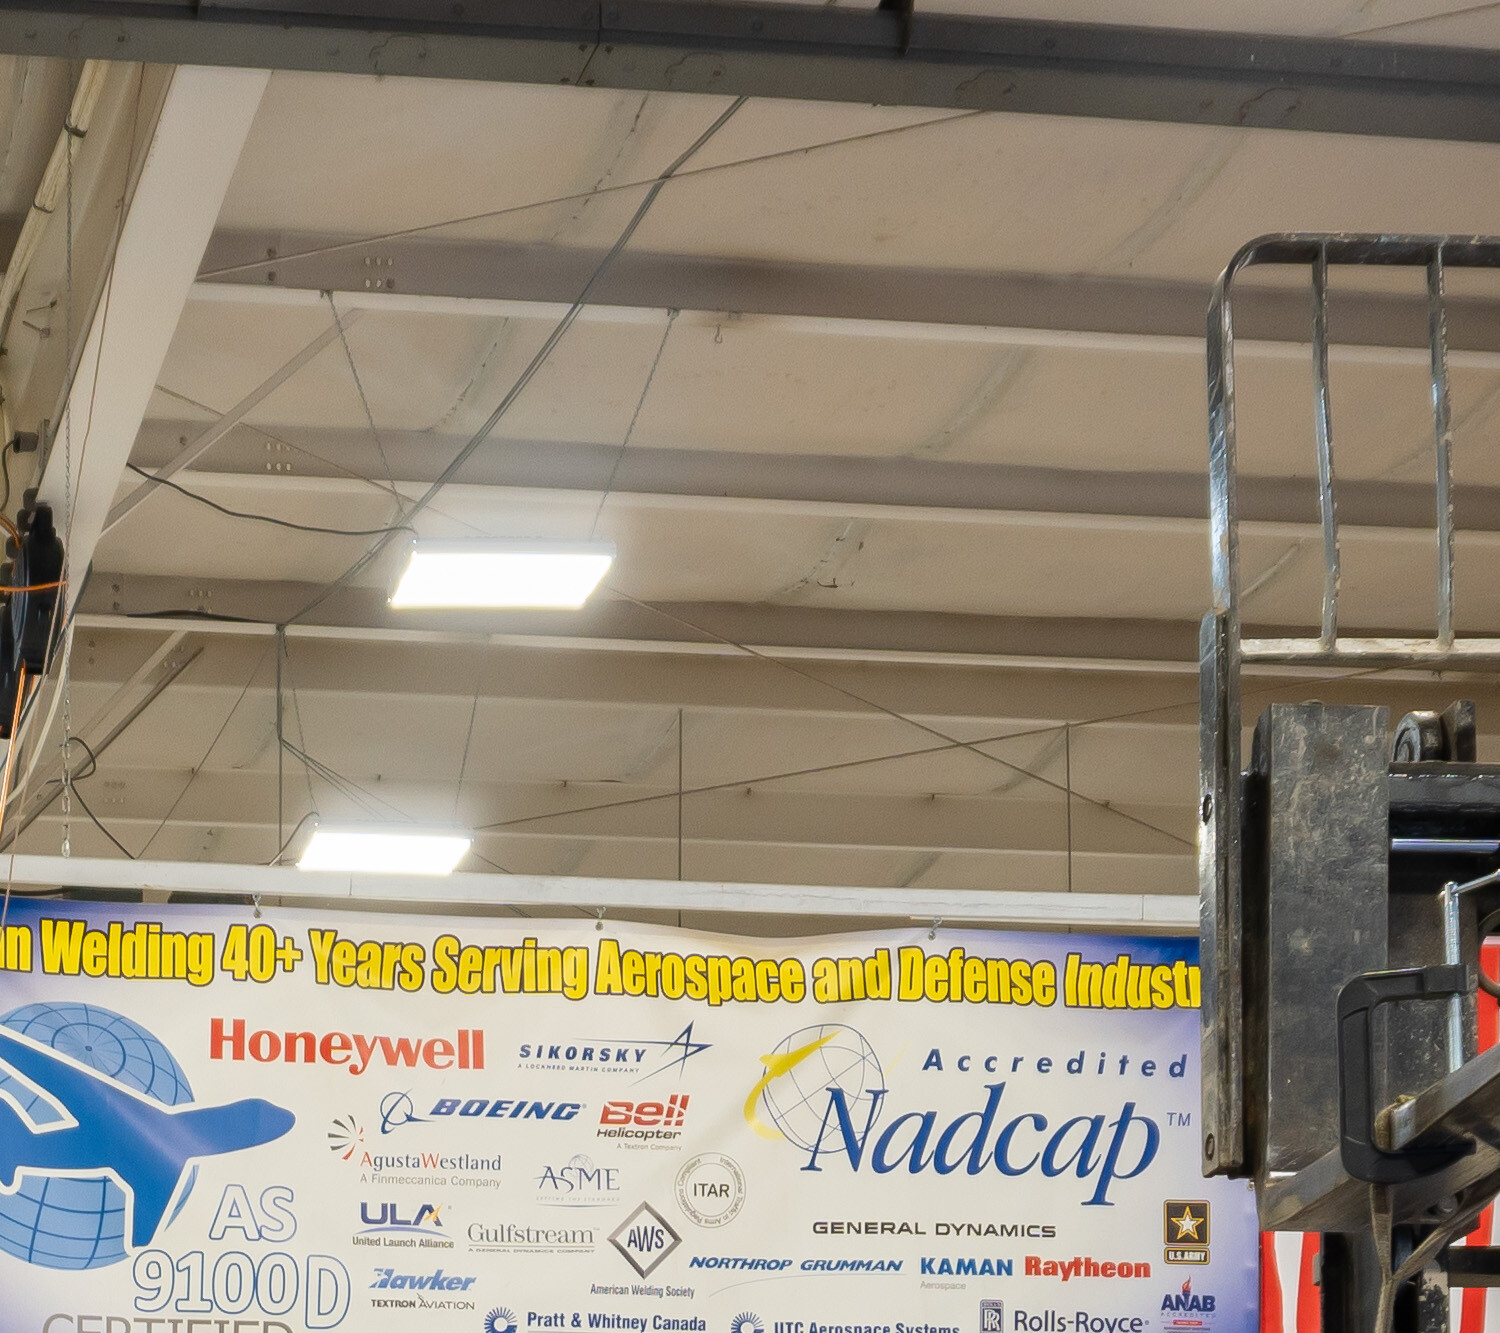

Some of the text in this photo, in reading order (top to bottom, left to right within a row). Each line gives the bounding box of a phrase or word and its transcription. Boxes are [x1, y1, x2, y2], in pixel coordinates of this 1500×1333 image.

[40, 918, 215, 987] Welding
[221, 924, 303, 984] 40+
[307, 929, 425, 991] Years
[431, 935, 589, 1000] Serving
[595, 938, 806, 1007] Aerospace
[811, 946, 891, 1004] and
[899, 945, 1057, 1009] Defense
[1063, 952, 1201, 1010] Industr
[209, 1017, 485, 1076] Honeywell
[519, 1044, 647, 1062] SIKORSKY
[922, 1048, 1187, 1079] Accredited
[430, 1098, 582, 1121] BOEING
[599, 1094, 690, 1127] Bell
[596, 1127, 682, 1141] Helicopter
[801, 1081, 1161, 1207] Nadcap
[360, 1151, 502, 1171] AgustaWestland
[360, 1174, 502, 1190] A Finmeccanica Company
[535, 1165, 621, 1194] ASME
[693, 1182, 730, 1198] ITAR
[209, 1182, 298, 1243] AS
[360, 1201, 444, 1227] ULA
[467, 1222, 594, 1244] Gulfstream
[626, 1225, 665, 1252] AWS
[812, 1220, 1057, 1239] GENERAL DYNAMICS
[352, 1236, 455, 1249] United Launch Alliance
[688, 1256, 904, 1273] NORTHROP GRUMMAN
[920, 1257, 1013, 1277] KAMAN
[1024, 1255, 1152, 1282] Raytheon
[368, 1267, 477, 1291] Hawker
[920, 1281, 967, 1291] Aerospace
[590, 1283, 696, 1300] American Welding Society
[1160, 1293, 1216, 1312] ANAB
[371, 1296, 476, 1310] TEXTRON AVIATION
[527, 1311, 706, 1333] Pratt & Whitney Canada
